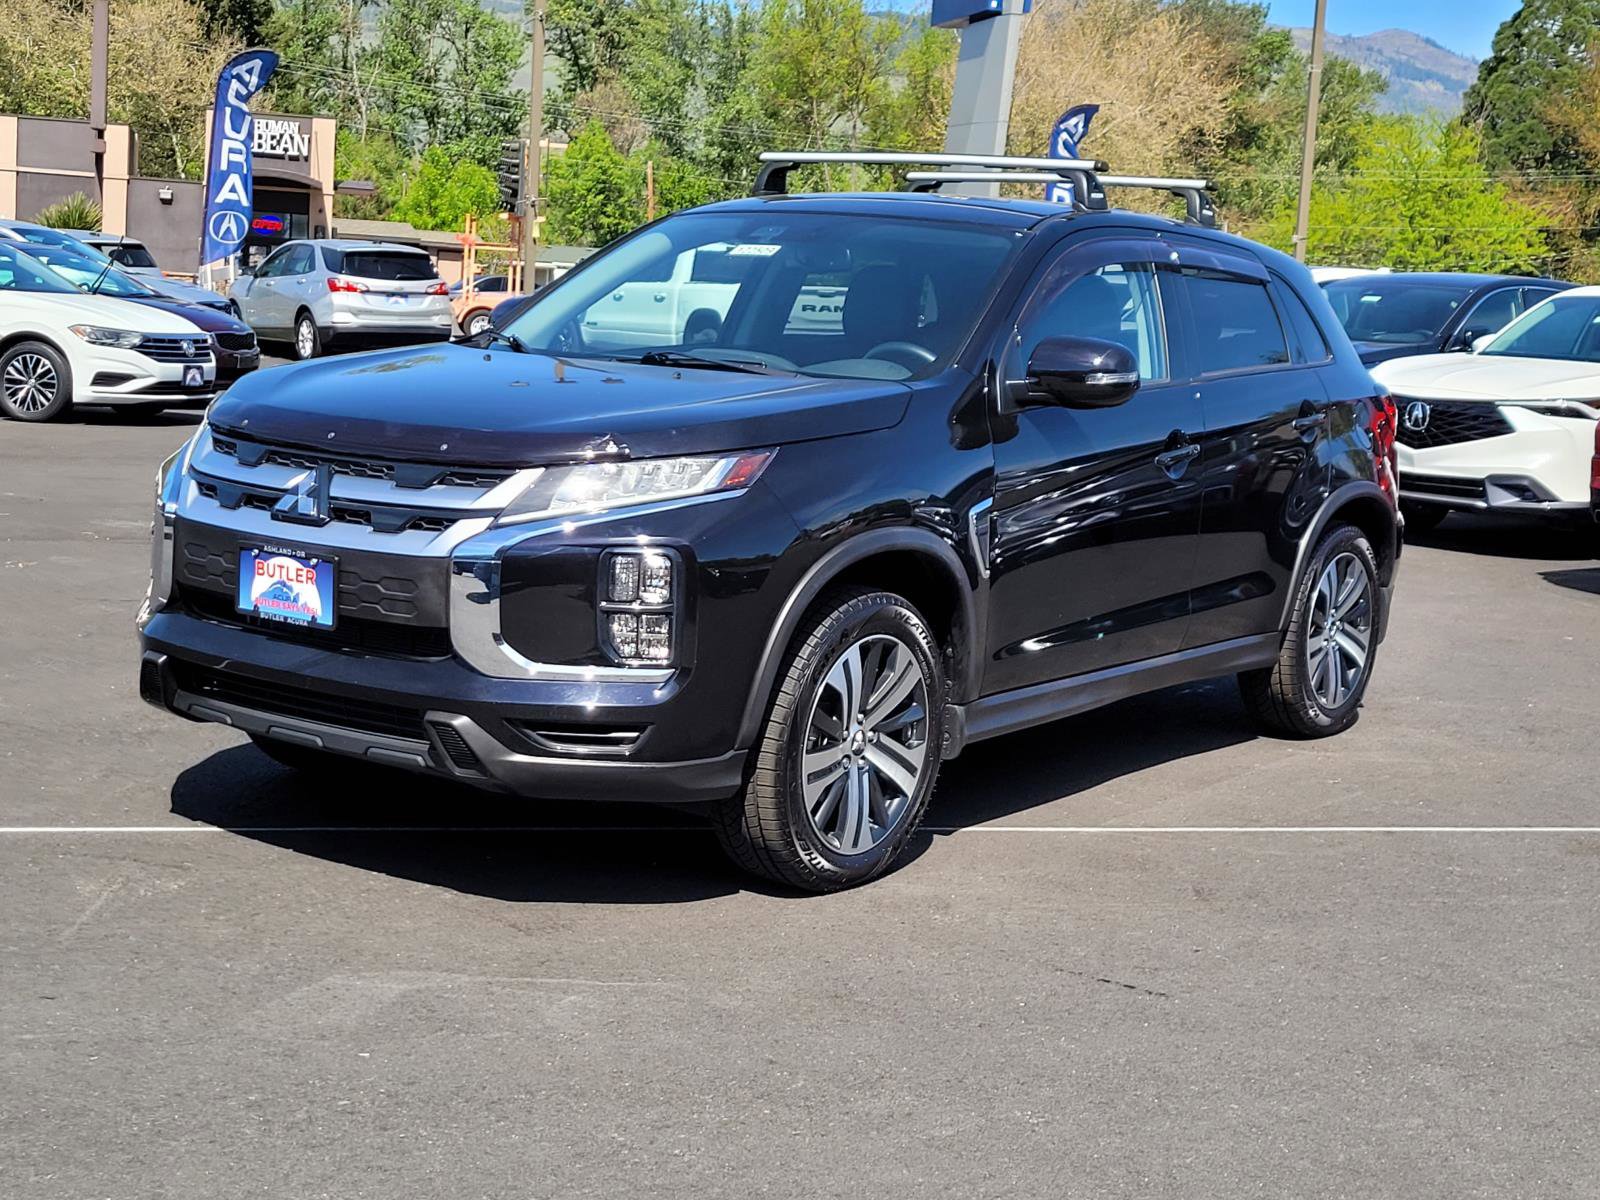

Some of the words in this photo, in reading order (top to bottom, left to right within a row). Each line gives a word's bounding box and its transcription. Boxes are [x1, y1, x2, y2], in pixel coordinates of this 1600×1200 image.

[214, 58, 263, 207] ACURA
[254, 119, 299, 134] HUMAN
[252, 131, 311, 156] BEAN
[252, 218, 284, 231] OPEN
[255, 560, 316, 585] BUTLER
[272, 593, 298, 604] ACURA
[260, 611, 284, 622] BUTLER
[287, 616, 308, 627] ACURA
